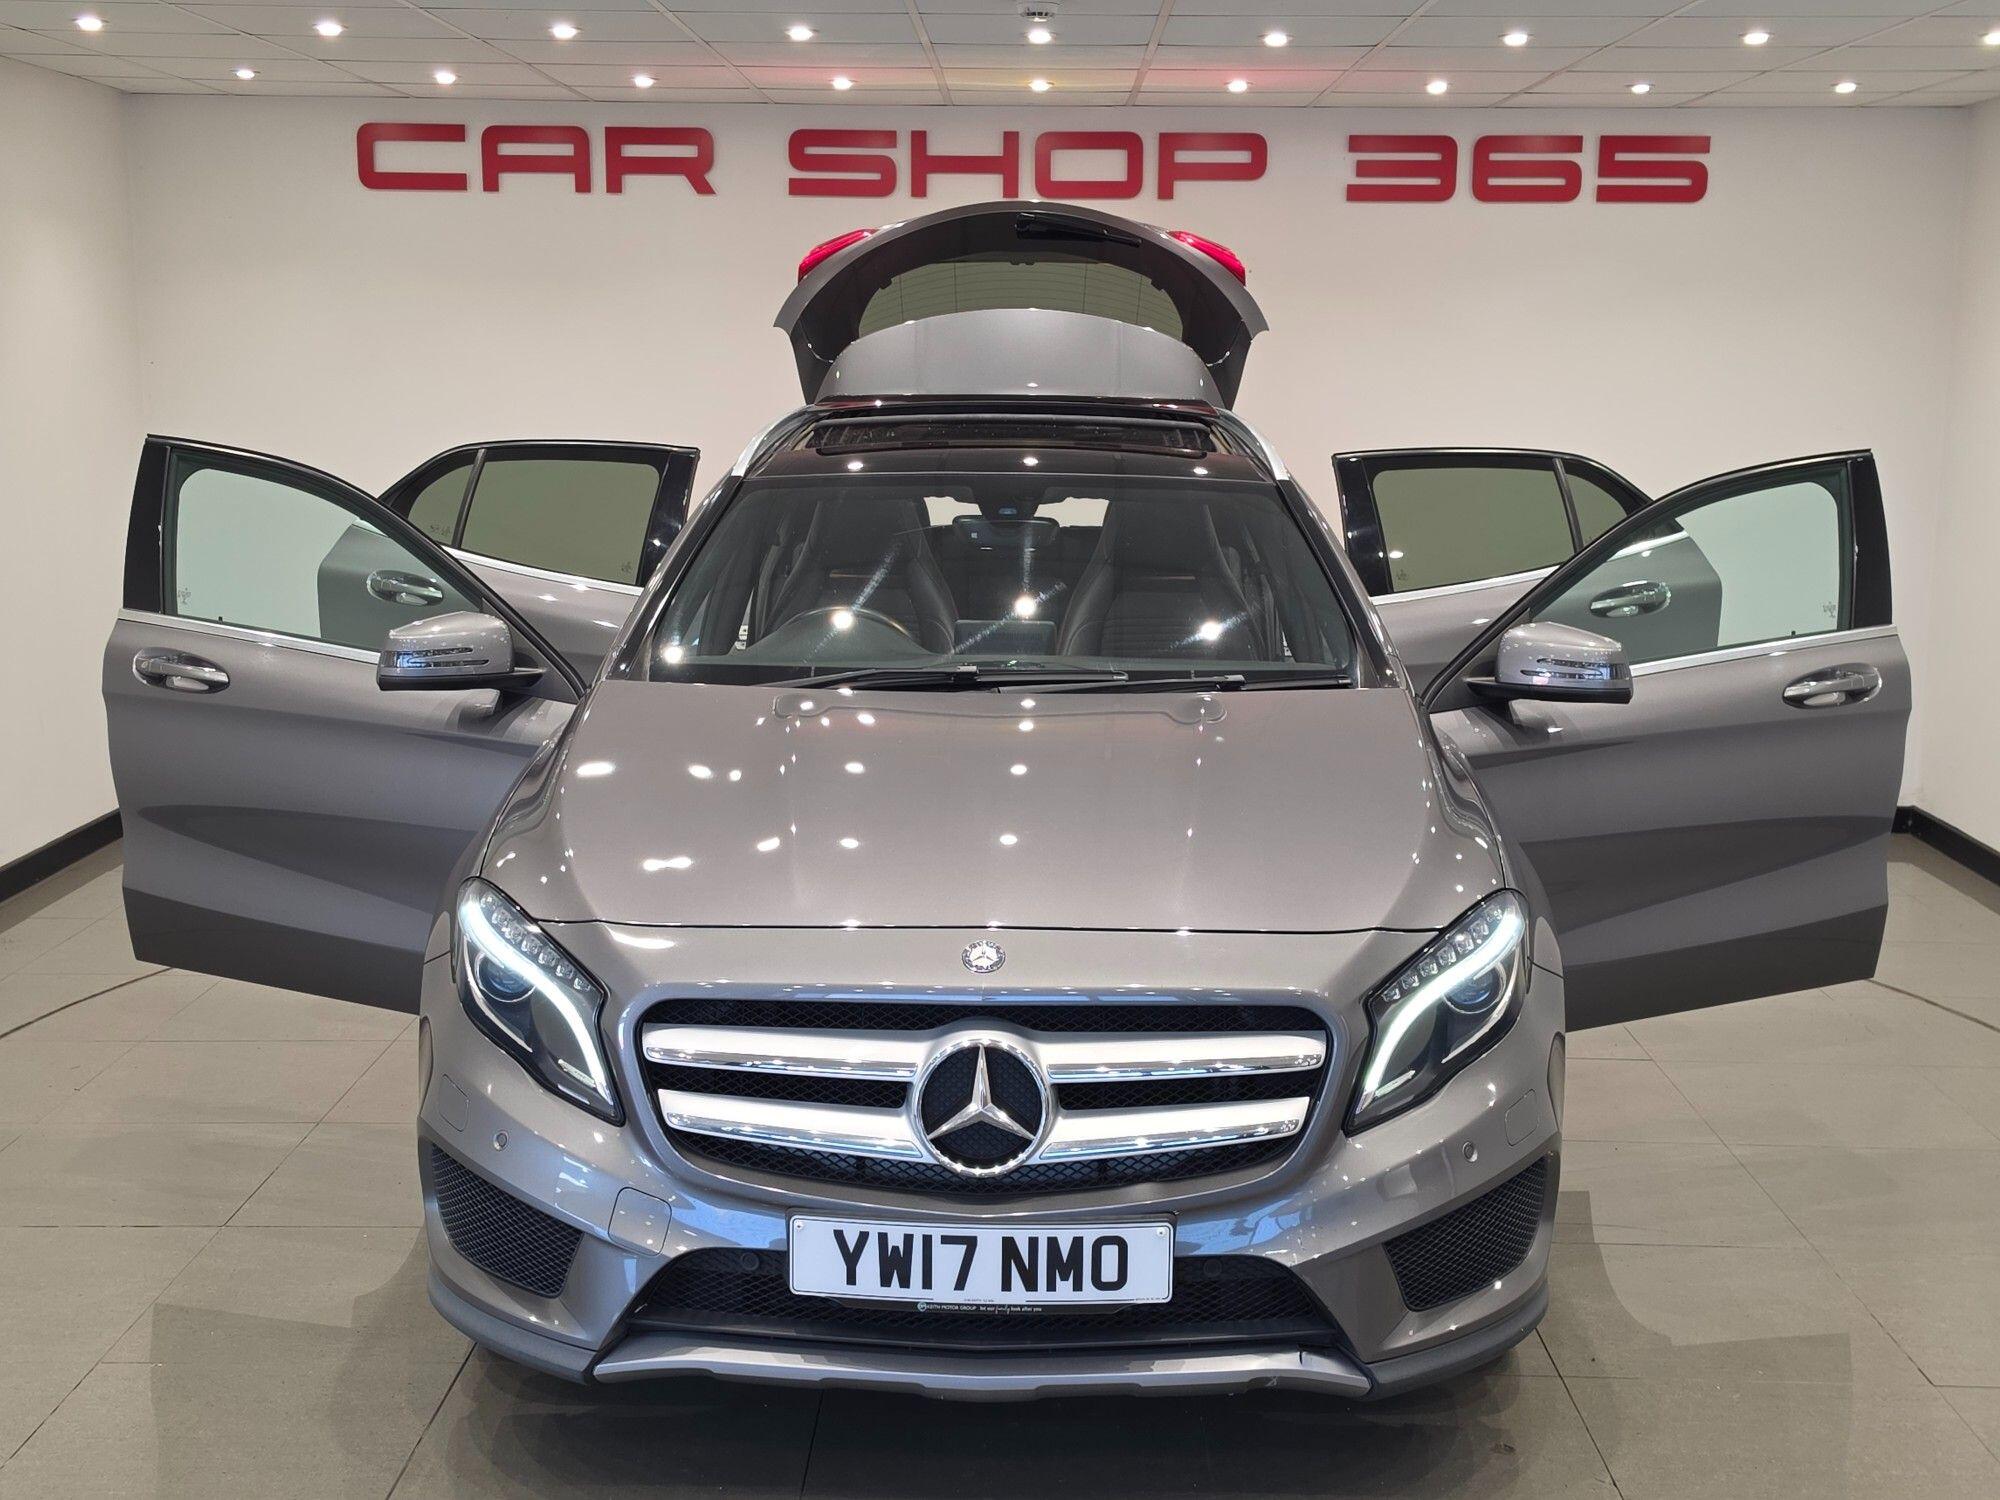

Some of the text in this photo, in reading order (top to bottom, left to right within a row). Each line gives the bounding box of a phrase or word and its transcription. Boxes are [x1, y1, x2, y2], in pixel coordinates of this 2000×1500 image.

[356, 122, 1712, 204] CAR SHOP 365
[833, 1229, 1129, 1293] YW17 NMO
